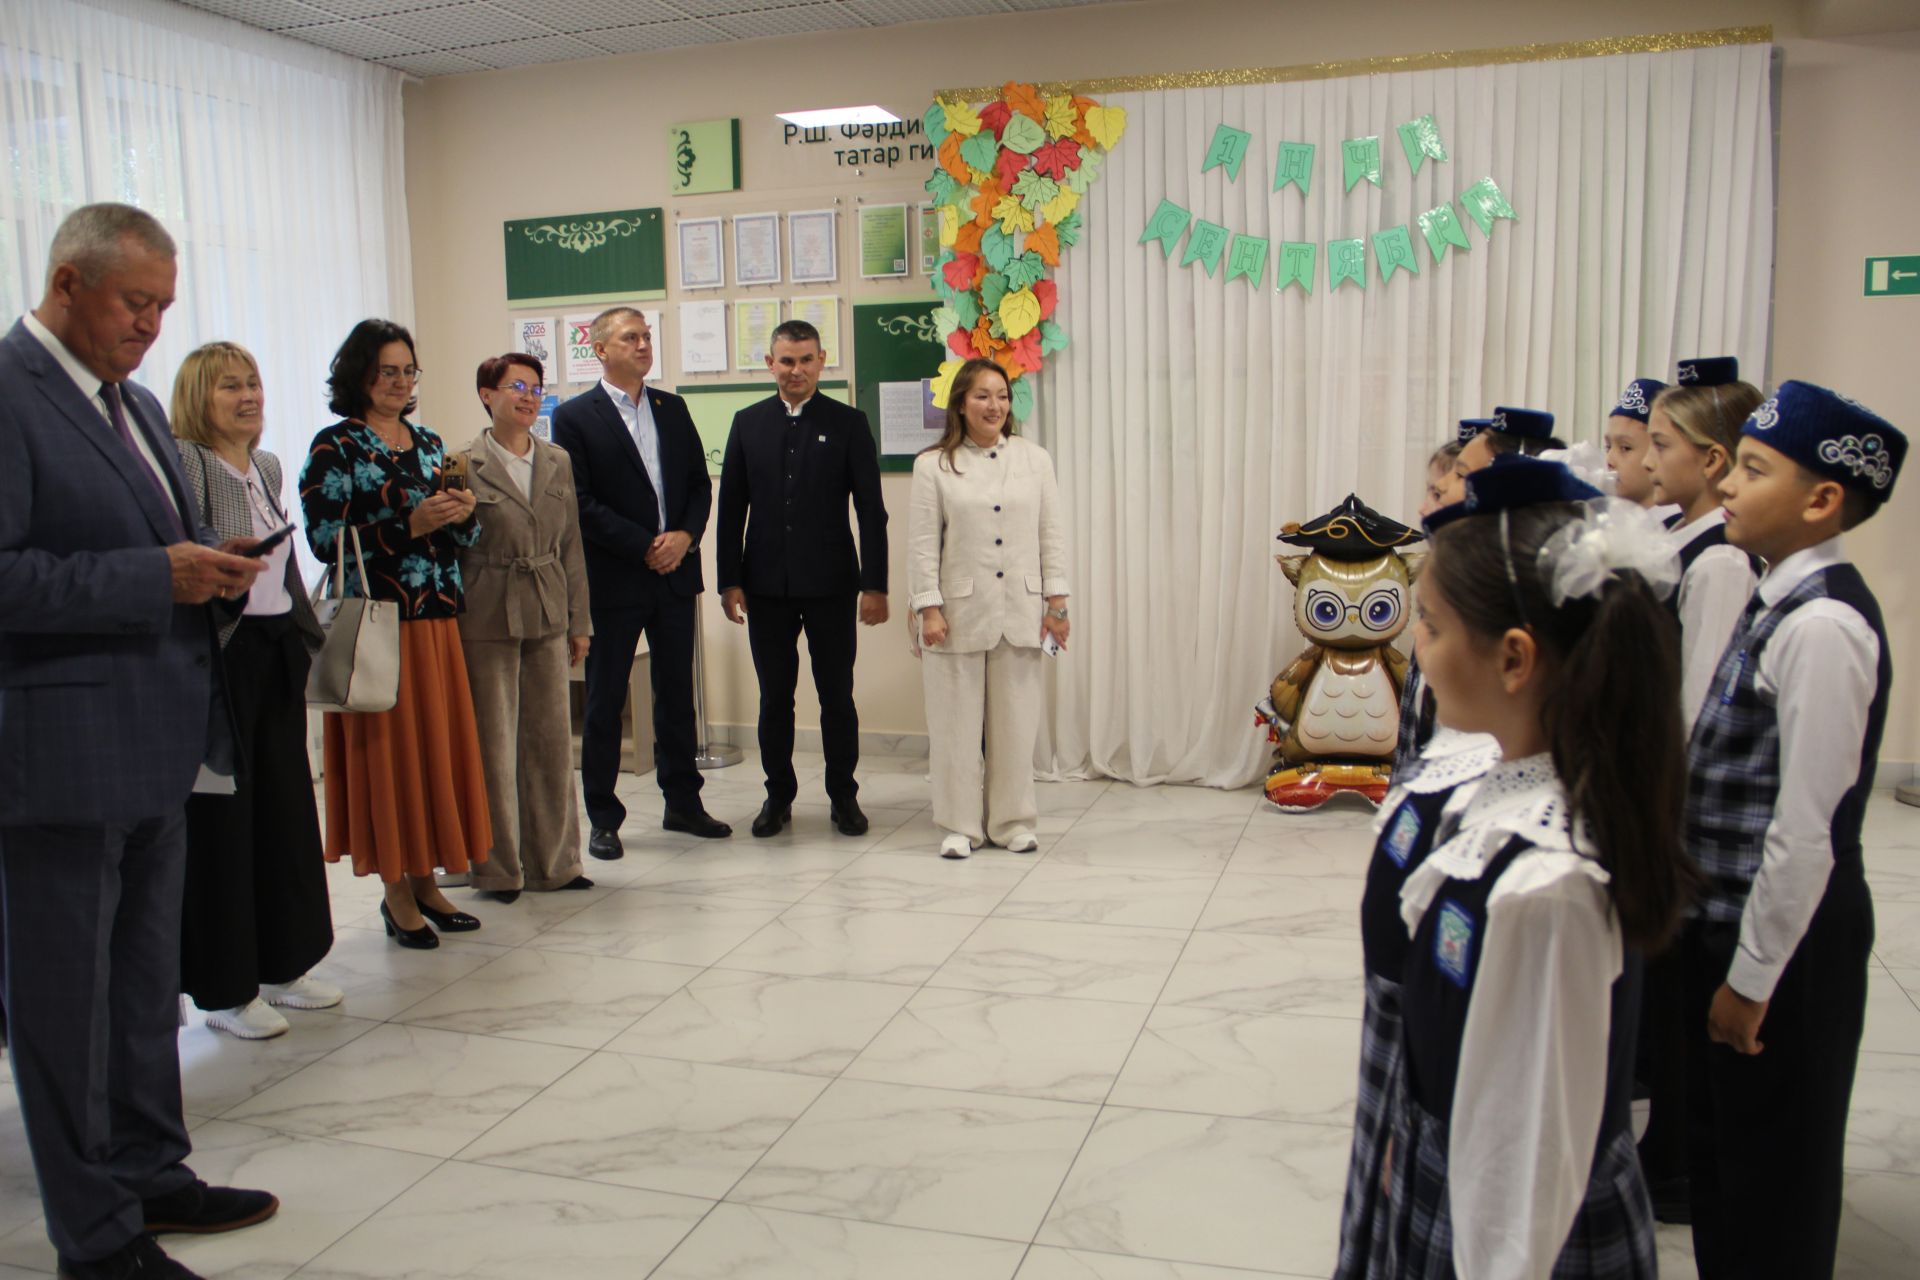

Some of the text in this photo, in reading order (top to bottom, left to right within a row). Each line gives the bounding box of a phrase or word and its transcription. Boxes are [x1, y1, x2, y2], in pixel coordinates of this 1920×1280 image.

[783, 118, 926, 145] Р.Ш. Фәрди
[834, 147, 900, 168] татар
[523, 325, 546, 335] 2026
[572, 346, 596, 360] 202
